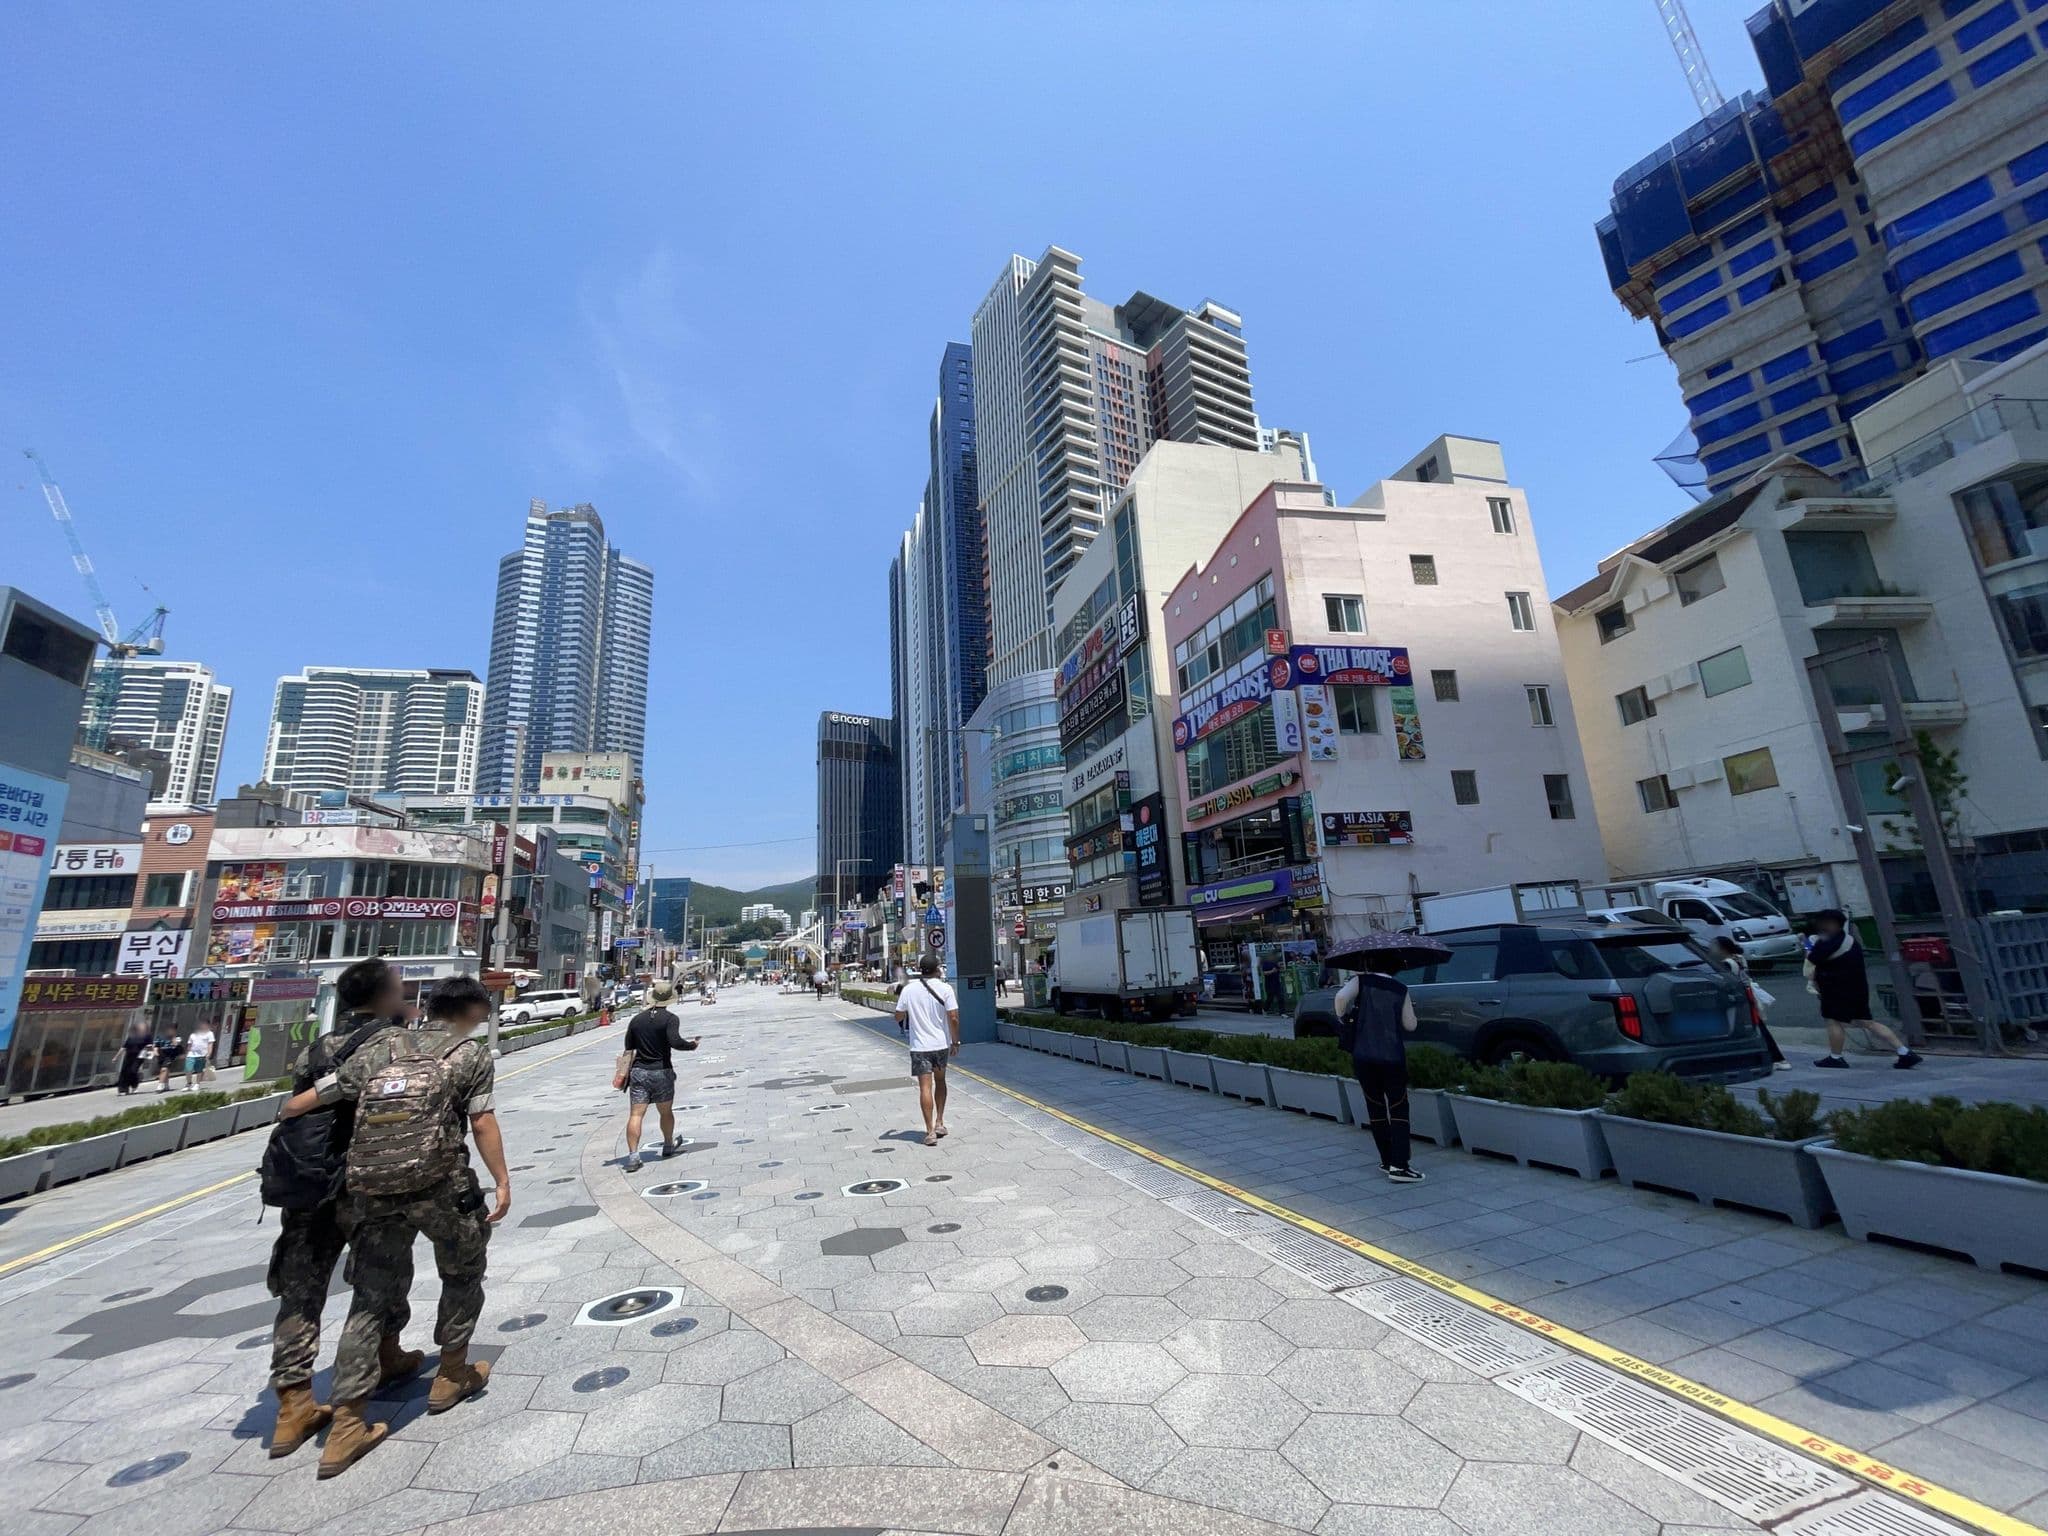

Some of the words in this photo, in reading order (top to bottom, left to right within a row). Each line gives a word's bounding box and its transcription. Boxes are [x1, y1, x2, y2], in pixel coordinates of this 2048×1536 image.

[1121, 618, 1136, 642] PC
[1315, 647, 1349, 678] THAI
[1352, 648, 1395, 677] HOUSE
[1186, 702, 1220, 739] THAI
[1222, 664, 1272, 707] HOUSE
[1285, 722, 1298, 747] CU
[1226, 785, 1253, 809] ASIA
[23, 810, 49, 827] 시간
[1343, 813, 1356, 825] HI
[1359, 813, 1386, 824] ASIA
[1389, 813, 1400, 822] 2F
[1135, 823, 1159, 848] 해운대
[1140, 846, 1157, 867] 포차
[1204, 889, 1217, 903] CU
[228, 905, 263, 918] INDIAN
[266, 903, 325, 917] RESTAURANT
[364, 900, 441, 917] BOMBAY
[126, 934, 184, 957] 부산
[114, 984, 139, 1001] 전문
[1612, 1355, 1644, 1371] STEP
[1641, 1367, 1678, 1386] YOUR
[1678, 1382, 1729, 1408] WATCH
[1800, 1436, 1934, 1496] 보행주의
